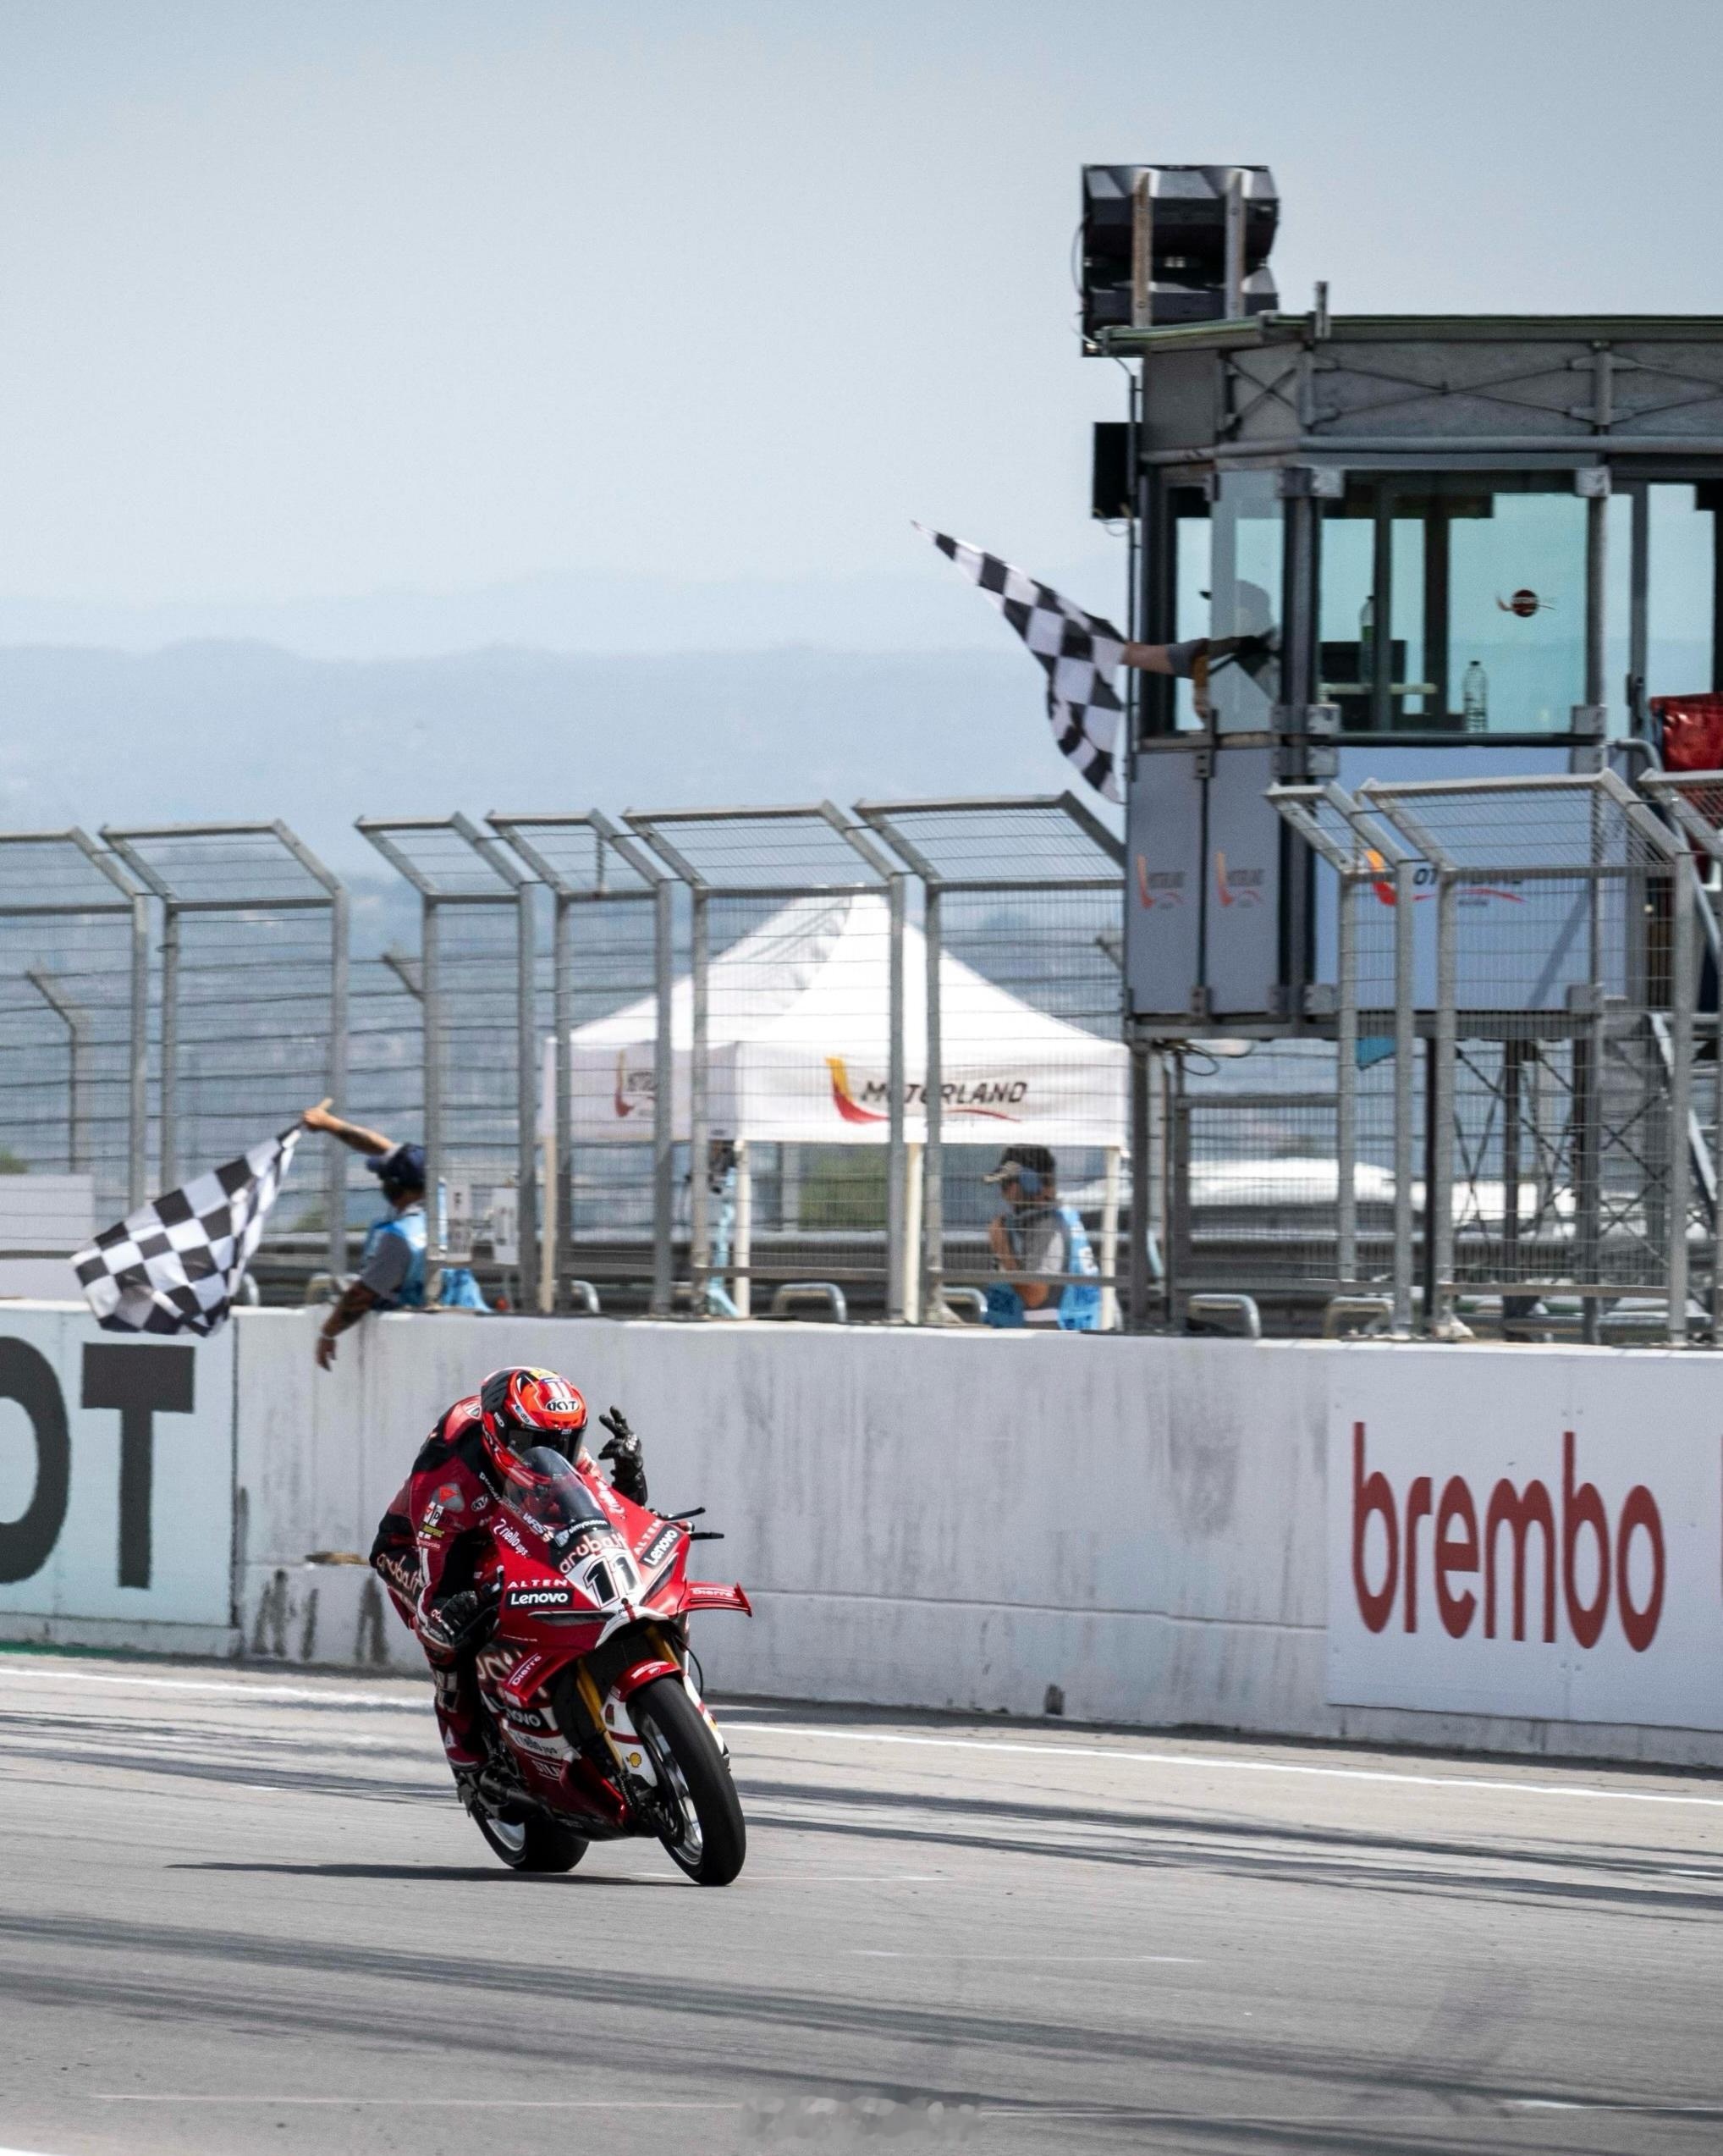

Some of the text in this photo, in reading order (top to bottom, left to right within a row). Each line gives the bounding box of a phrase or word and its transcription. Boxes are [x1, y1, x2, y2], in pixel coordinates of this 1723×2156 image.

[861, 1081, 1027, 1105] MTRLAND
[547, 1400, 577, 1412] KYT
[634, 1519, 663, 1556] ALTEN
[643, 1530, 678, 1565] Lenovo
[1351, 1421, 1665, 1652] brembo
[508, 1579, 568, 1589] ALTEN
[583, 1554, 638, 1608] 11
[510, 1592, 569, 1606] Lenovo
[512, 1654, 542, 1686] Dierre
